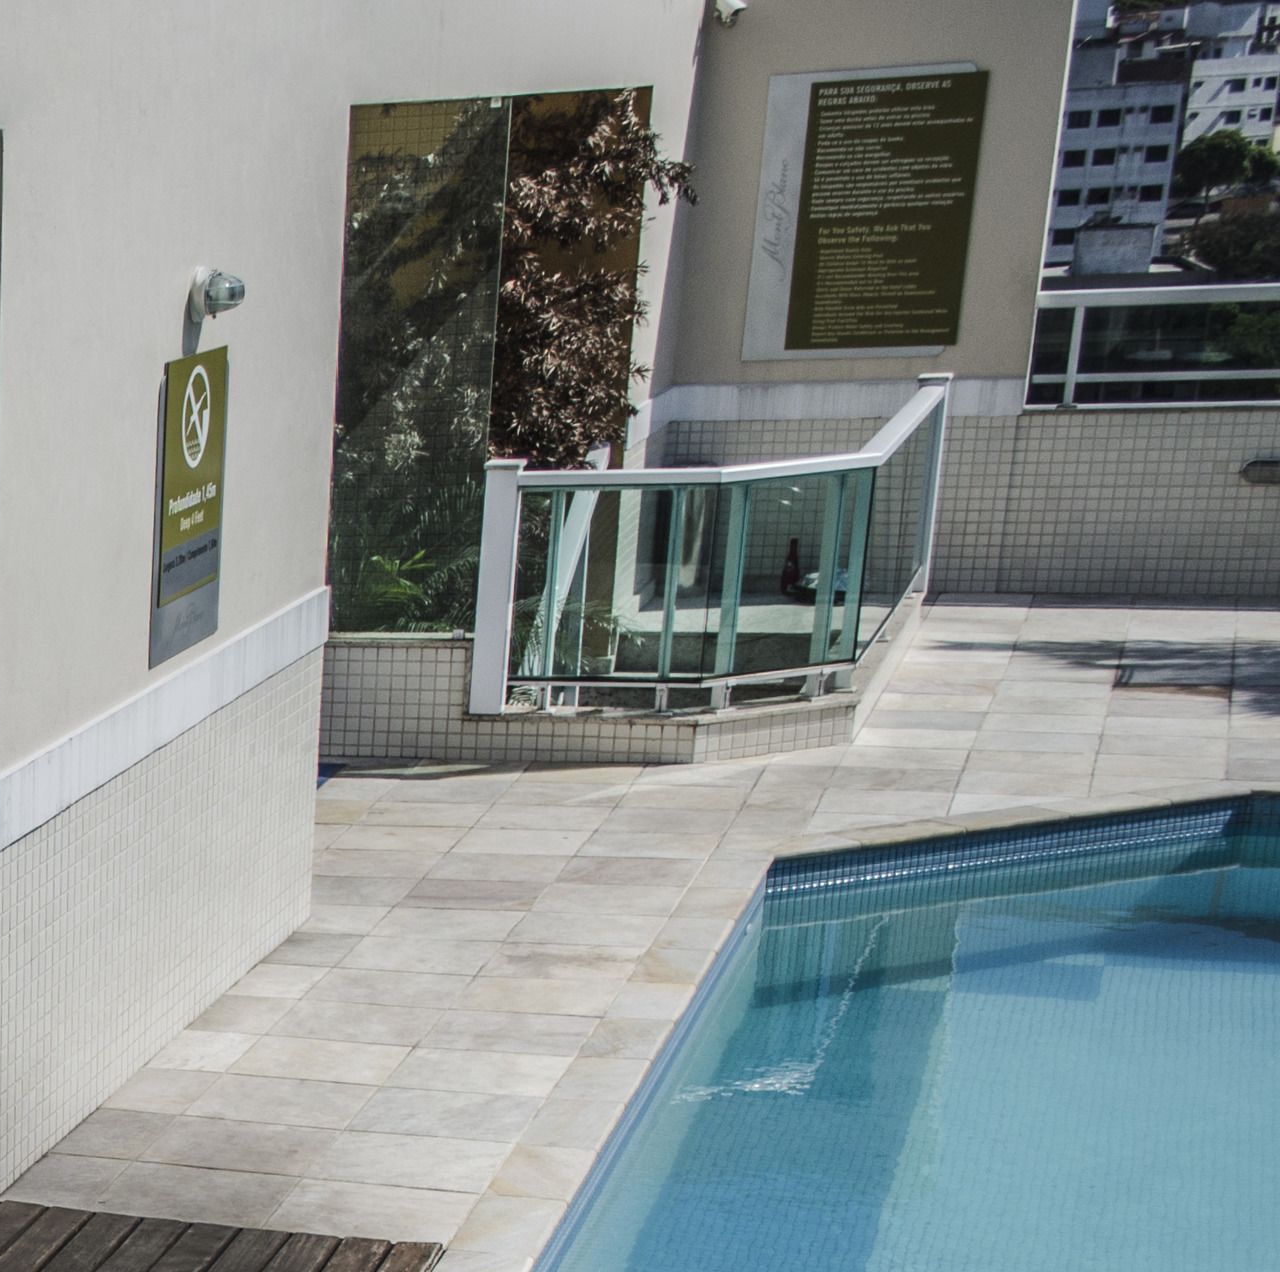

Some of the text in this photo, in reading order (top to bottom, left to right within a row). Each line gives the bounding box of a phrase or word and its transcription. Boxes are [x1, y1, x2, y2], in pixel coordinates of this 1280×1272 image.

[819, 87, 838, 96] PARA
[906, 80, 940, 91] OBSERVE
[942, 79, 953, 89] AS
[817, 96, 848, 107] REGRAS
[900, 223, 916, 232] That
[168, 487, 201, 516] Profundidade
